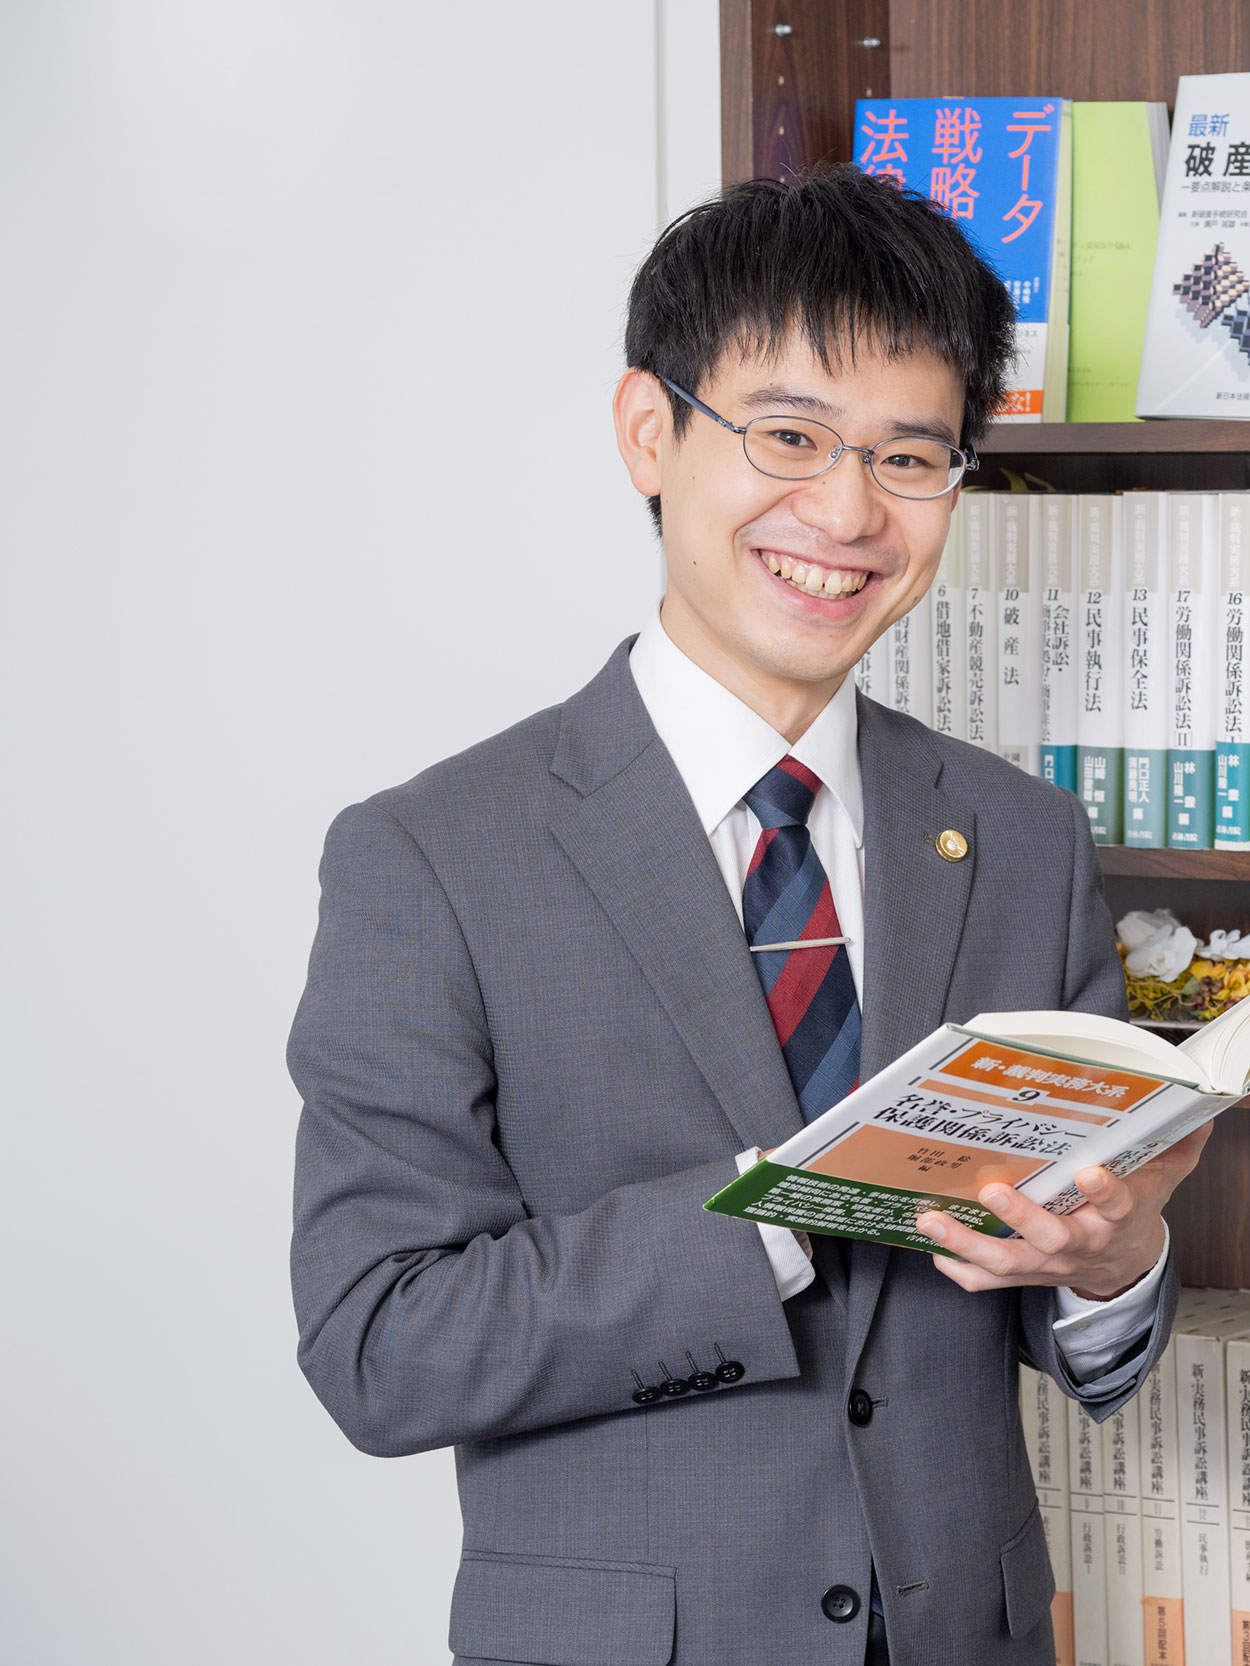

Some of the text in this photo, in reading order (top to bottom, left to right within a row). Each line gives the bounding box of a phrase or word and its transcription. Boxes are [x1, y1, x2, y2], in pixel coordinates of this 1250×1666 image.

[1188, 113, 1230, 137] 最新
[930, 108, 983, 220] 戦略
[1001, 104, 1055, 244] データ
[1216, 392, 1250, 401] 新日本法規
[938, 586, 946, 596] 6
[971, 588, 978, 599] 7
[1004, 588, 1019, 600] 10
[1047, 589, 1059, 600] 11
[1086, 592, 1102, 604] 12
[1132, 589, 1148, 601] 13
[1176, 590, 1190, 603] 17
[1227, 592, 1242, 605] 16
[1004, 606, 1020, 686] 破産法
[1085, 607, 1102, 713] 民事執行法
[1130, 606, 1148, 712] 民事保全法
[936, 601, 951, 732] 借地借家訴訟法
[969, 604, 984, 741] 不動産競売訴訟法
[1184, 762, 1196, 774] 林
[1228, 754, 1240, 767] 林
[1138, 757, 1150, 803] 門口正人
[970, 1057, 1130, 1098] 新・裁判実務大系
[1013, 1090, 1040, 1102] 9
[873, 1107, 1071, 1156] 保護関係訴訟法
[896, 1094, 1087, 1138] 名誉・プライバシー
[1192, 1363, 1208, 1500] 新・実務民事訴訟講座
[1157, 1606, 1166, 1662] 第5回配本
